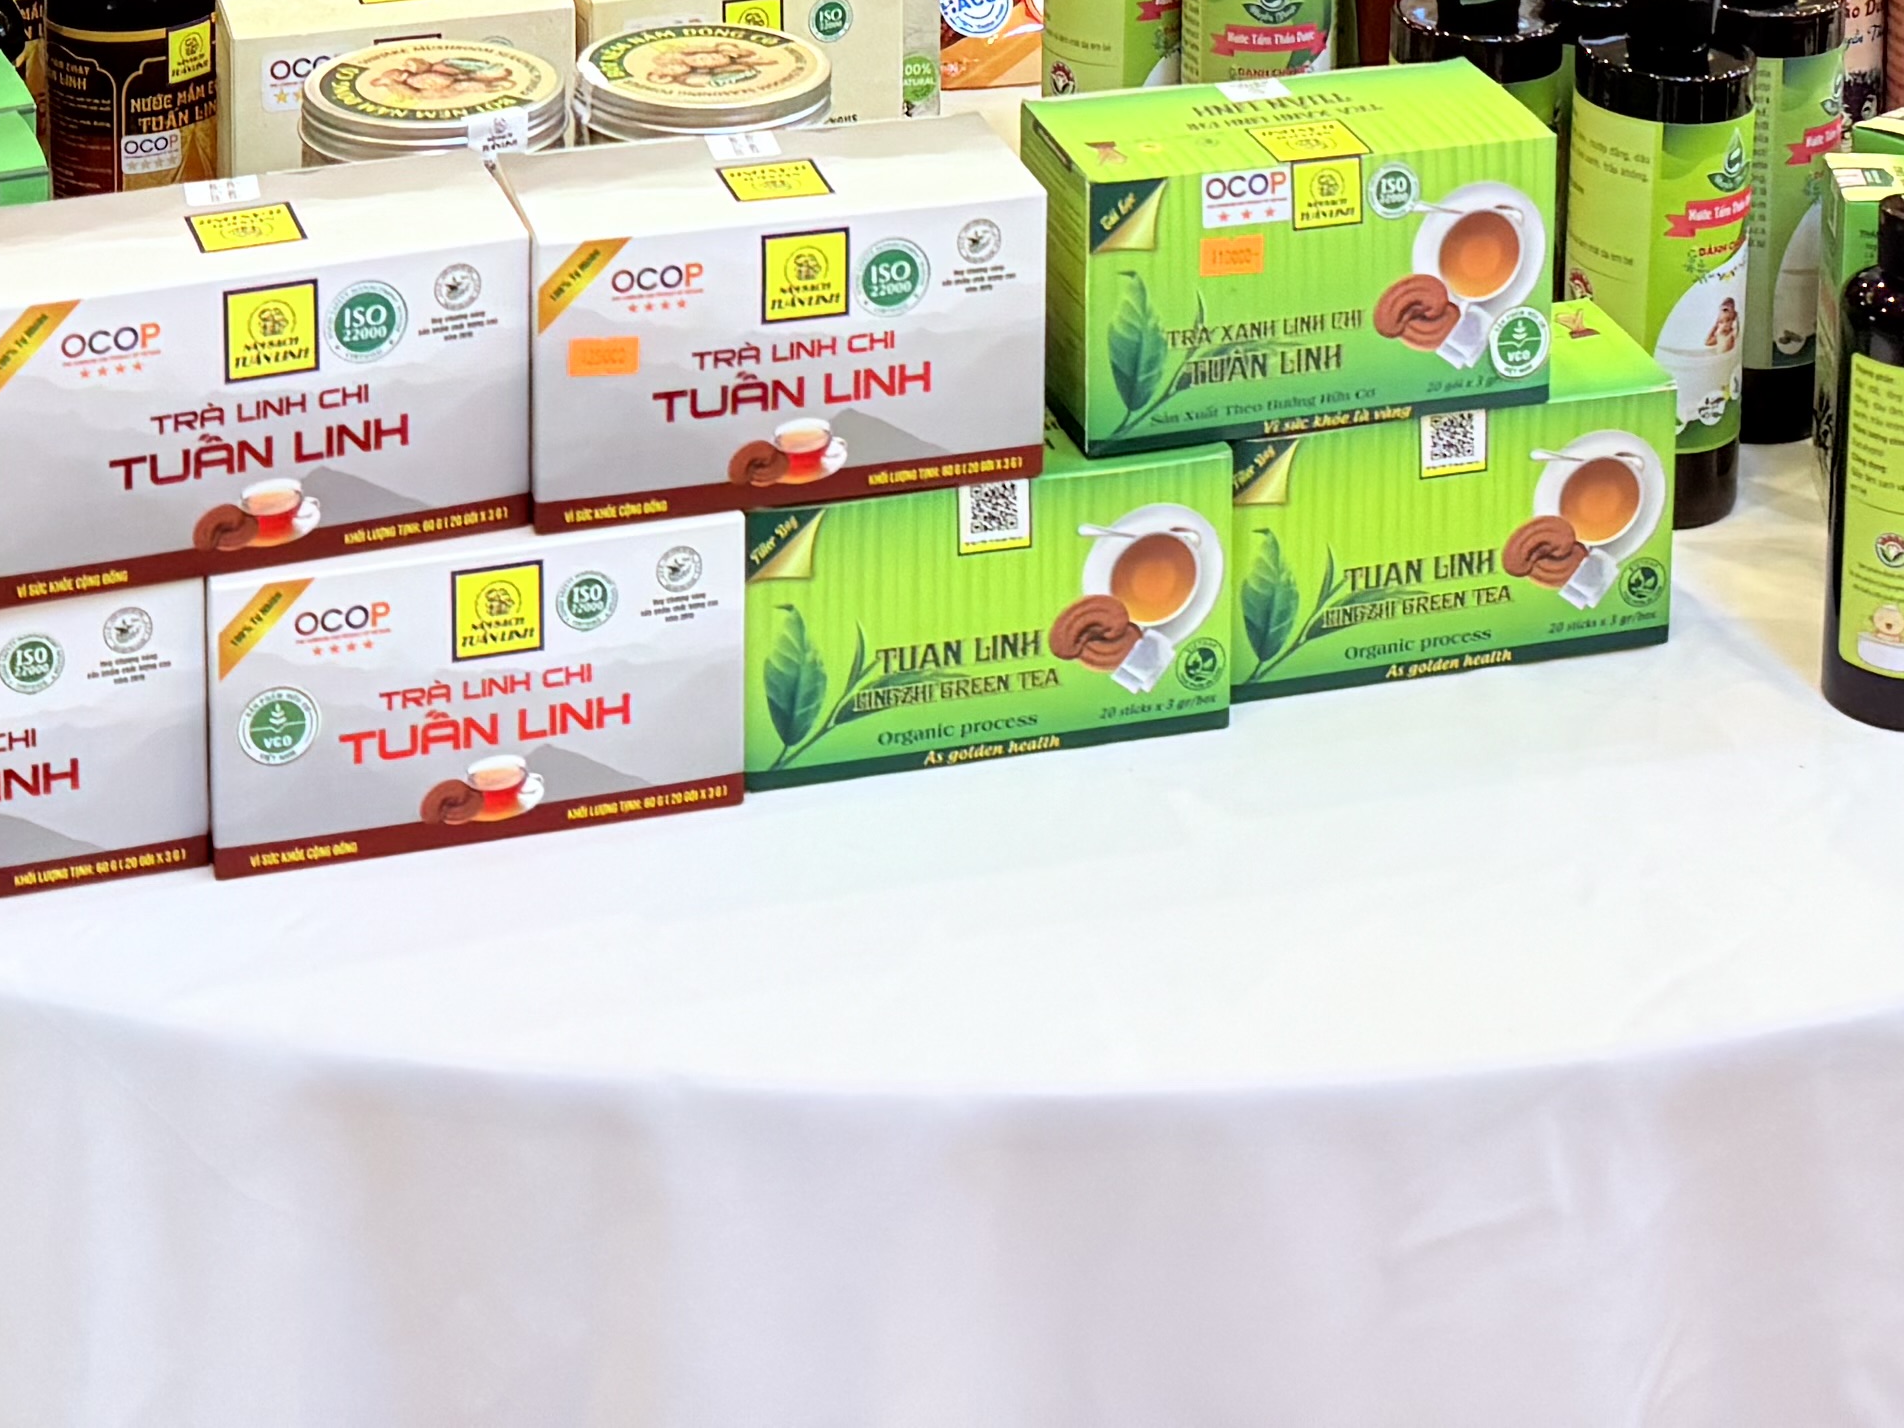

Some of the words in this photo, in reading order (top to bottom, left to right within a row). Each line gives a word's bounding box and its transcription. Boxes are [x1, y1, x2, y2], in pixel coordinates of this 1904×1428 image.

[124, 135, 178, 155] OCOP
[1205, 171, 1287, 201] OCOP
[1381, 175, 1405, 192] ISO
[612, 262, 704, 293] OCOP
[869, 260, 911, 282] ISO
[344, 304, 387, 328] ISO
[60, 321, 161, 358] OCOP
[342, 326, 388, 343] 22000
[691, 341, 761, 371] TRÀ
[772, 336, 837, 363] LINH
[847, 330, 895, 353] CHI
[652, 370, 805, 424] TUẤN
[824, 360, 932, 405] LINH
[150, 402, 225, 435] TRÀ
[237, 392, 306, 423] LINH
[318, 383, 369, 410] CHI
[108, 433, 274, 491] TUẤN
[294, 412, 409, 464] LINH
[1344, 558, 1424, 592] TUAN
[1434, 548, 1496, 580] LINH
[572, 584, 603, 603] ISO
[1402, 591, 1466, 616] GREEN
[1472, 584, 1512, 607] TEA
[294, 601, 391, 637] OCOP
[15, 647, 49, 667] ISO
[876, 637, 964, 677] TUAN
[974, 629, 1043, 663] LINH
[1344, 638, 1416, 662] Organic
[1420, 628, 1493, 651] process
[1386, 663, 1404, 679] As
[1407, 655, 1460, 679] golden
[1463, 649, 1513, 668] health
[379, 679, 451, 711] TRÀ
[463, 671, 531, 700] LINH
[542, 663, 593, 689] CHI
[940, 672, 1010, 700] GREEN
[1017, 667, 1061, 691] TEA
[262, 734, 293, 750] VCO
[339, 709, 499, 765] TUẤN
[517, 692, 631, 742] LINH
[877, 723, 955, 748] Organic
[960, 713, 1039, 739] process
[924, 749, 944, 767] As
[947, 742, 1005, 767] golden
[1008, 734, 1061, 754] health
